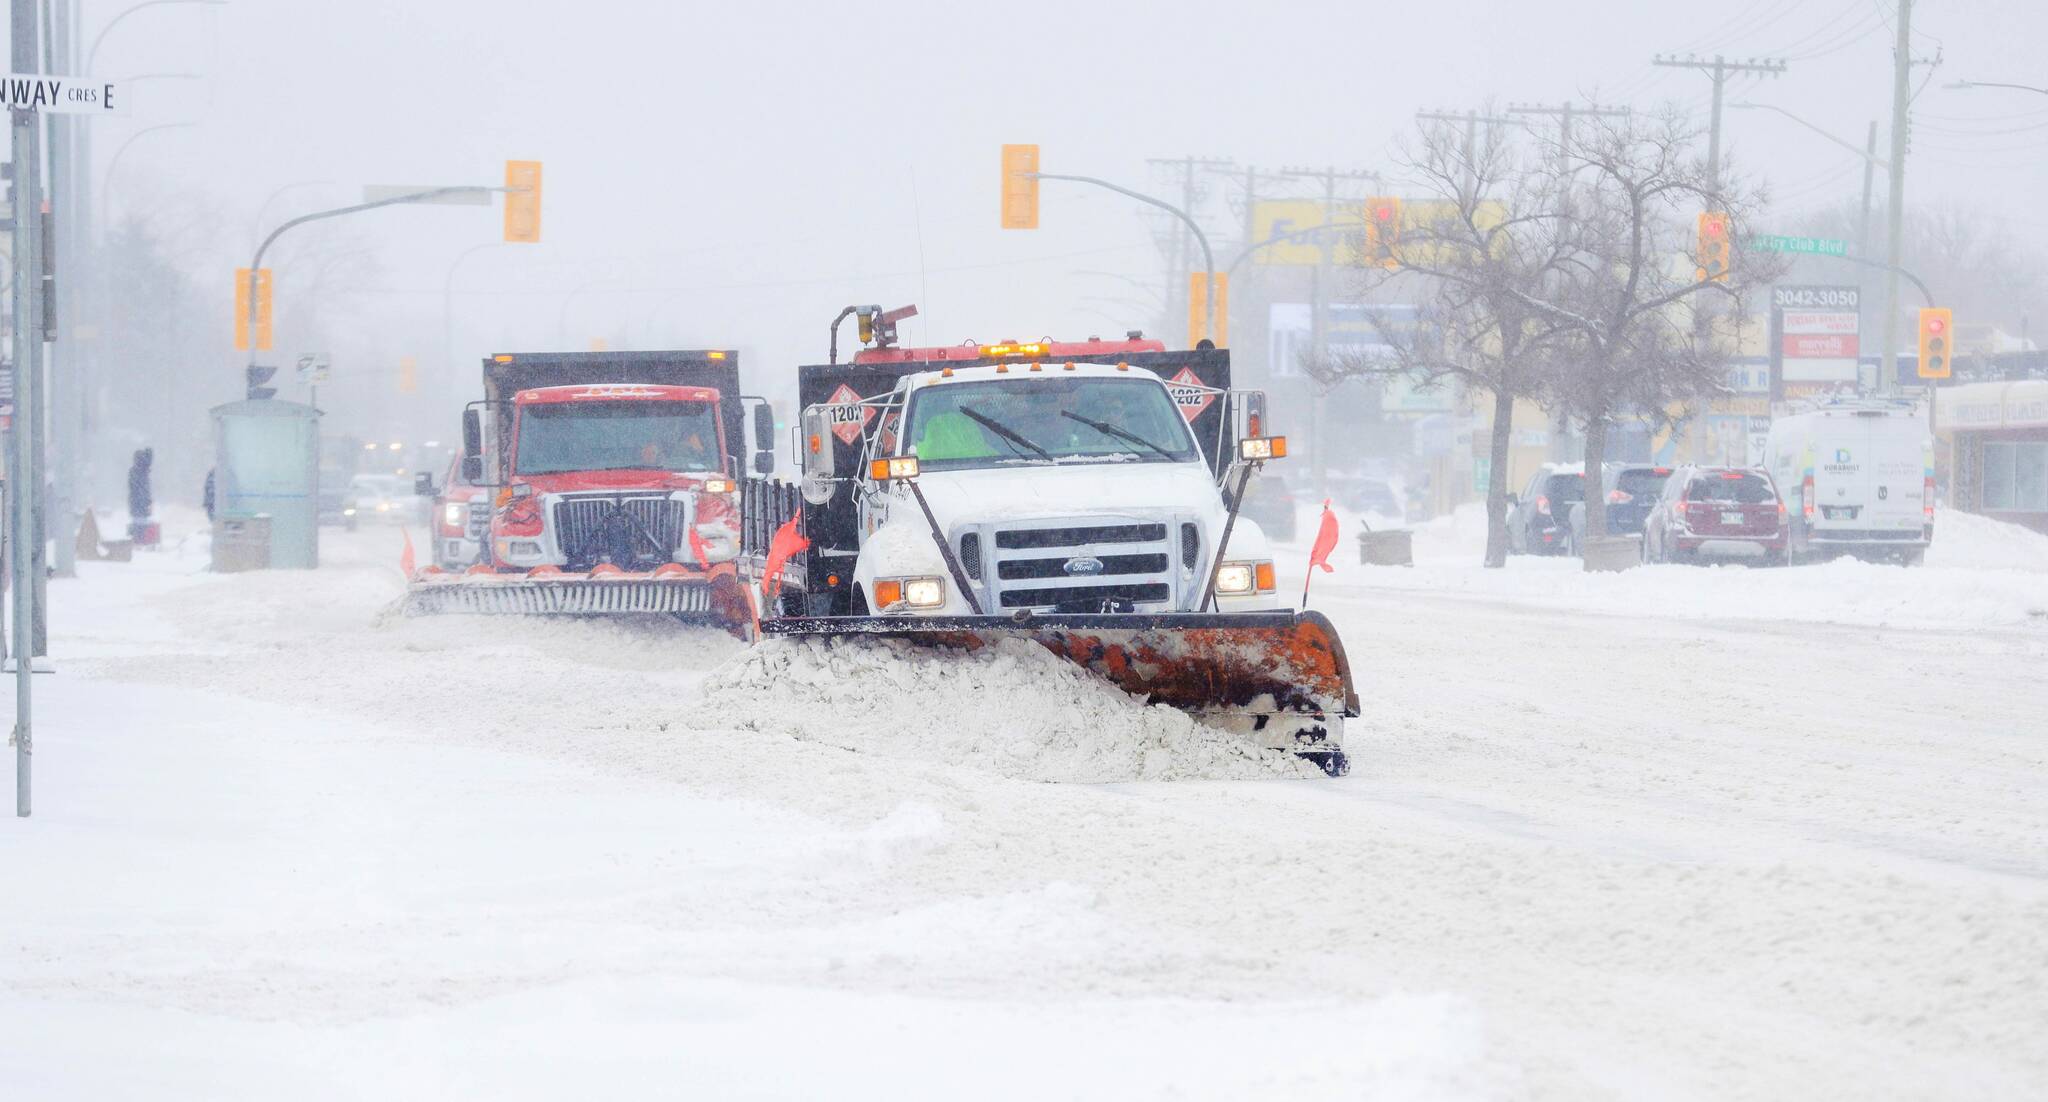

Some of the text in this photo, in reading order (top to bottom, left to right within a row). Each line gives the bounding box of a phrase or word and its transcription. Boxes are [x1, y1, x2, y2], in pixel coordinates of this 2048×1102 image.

[68, 88, 97, 102] CRES
[103, 84, 114, 109] E
[1790, 236, 1815, 251] Club
[1819, 239, 1843, 253] Blvd
[1775, 289, 1857, 305] 3042-3050
[1072, 561, 1096, 571] Ford
